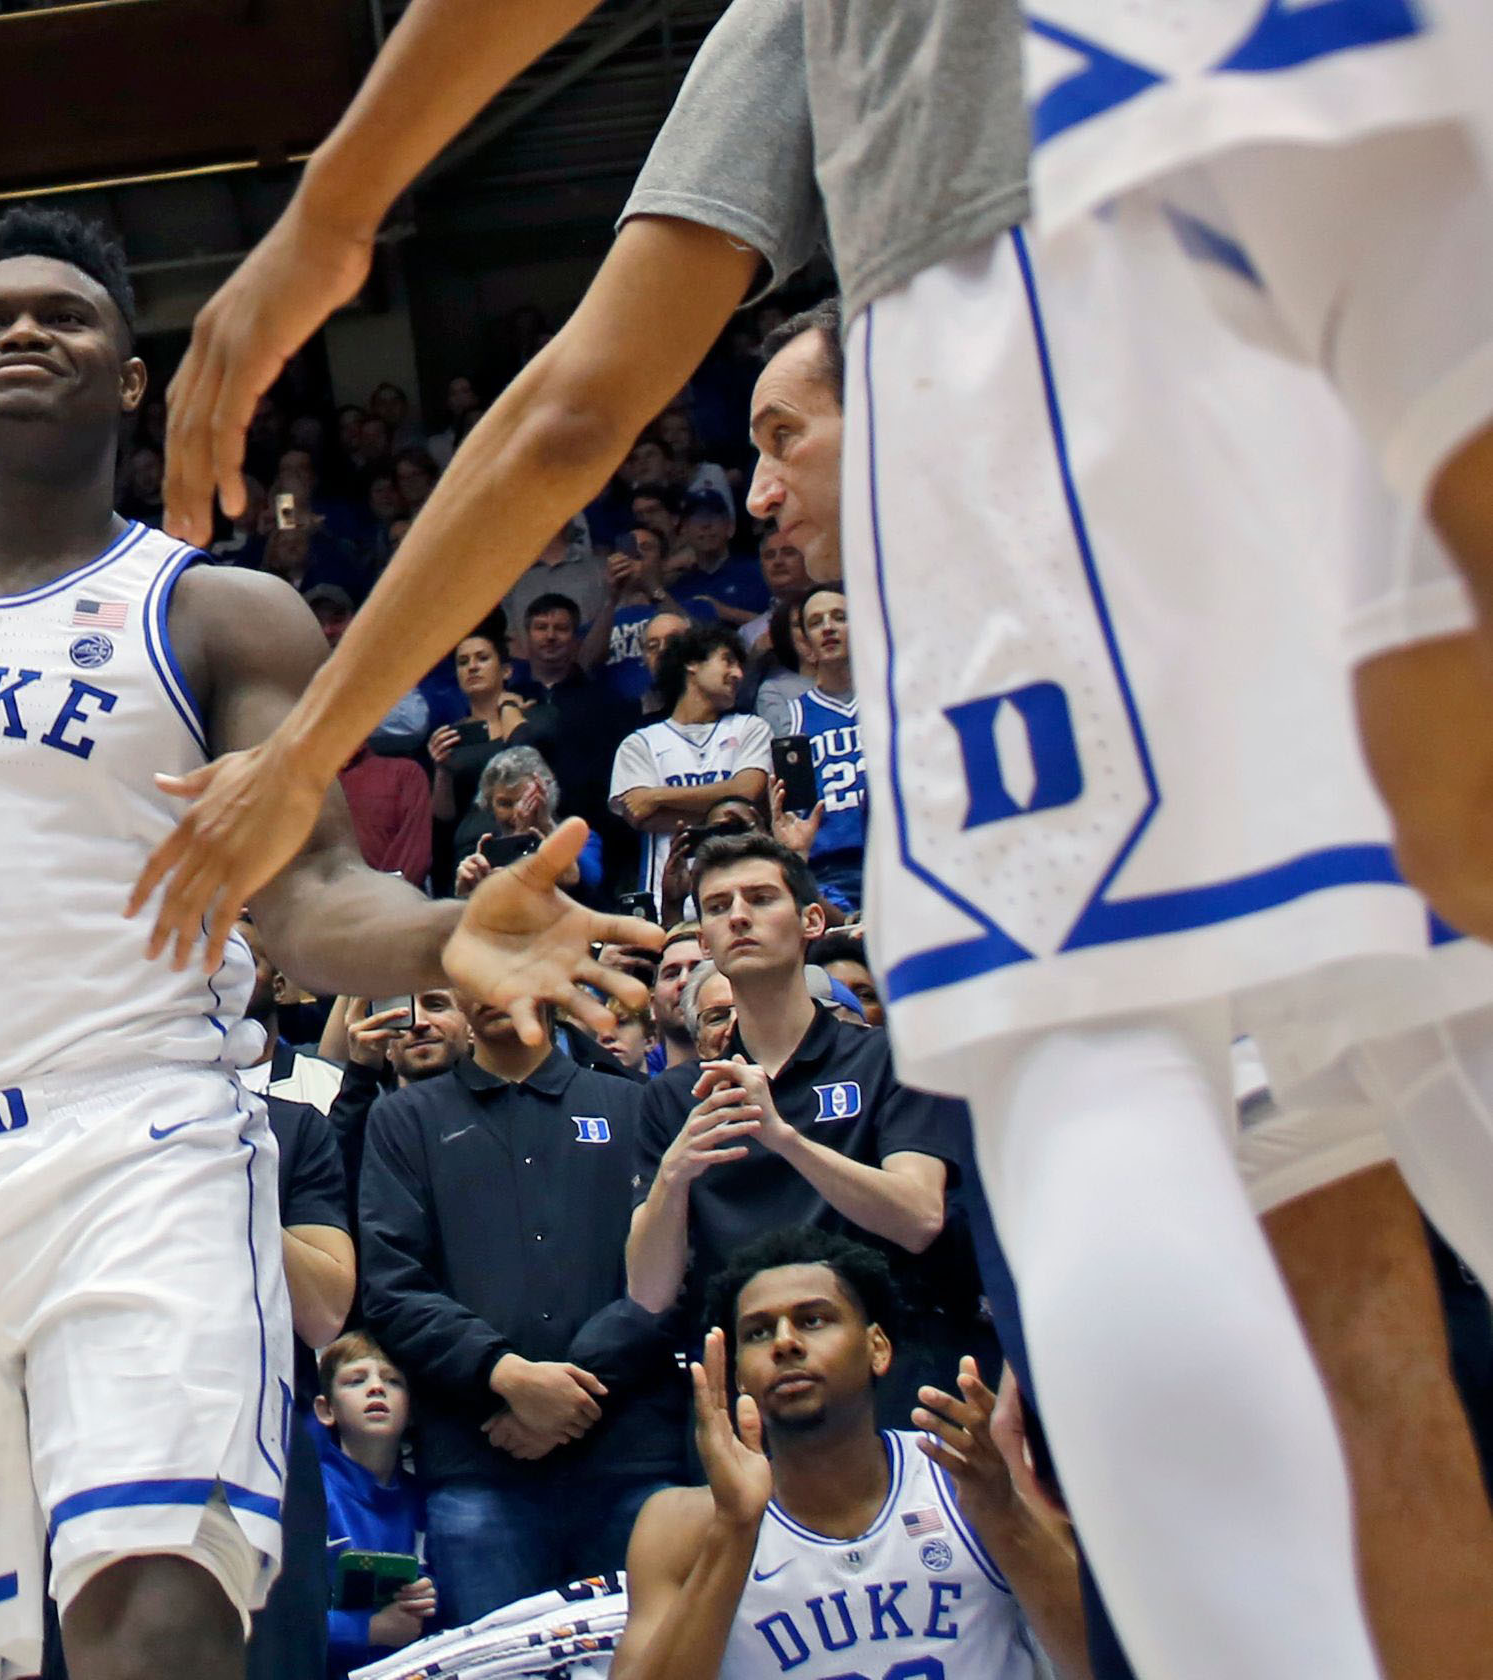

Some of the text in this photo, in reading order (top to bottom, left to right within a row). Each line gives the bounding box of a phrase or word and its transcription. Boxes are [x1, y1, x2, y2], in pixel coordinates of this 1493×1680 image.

[942, 679, 1084, 832] D
[571, 1116, 612, 1143] D
[813, 1080, 862, 1122] D
[754, 1580, 962, 1672] DUKE
